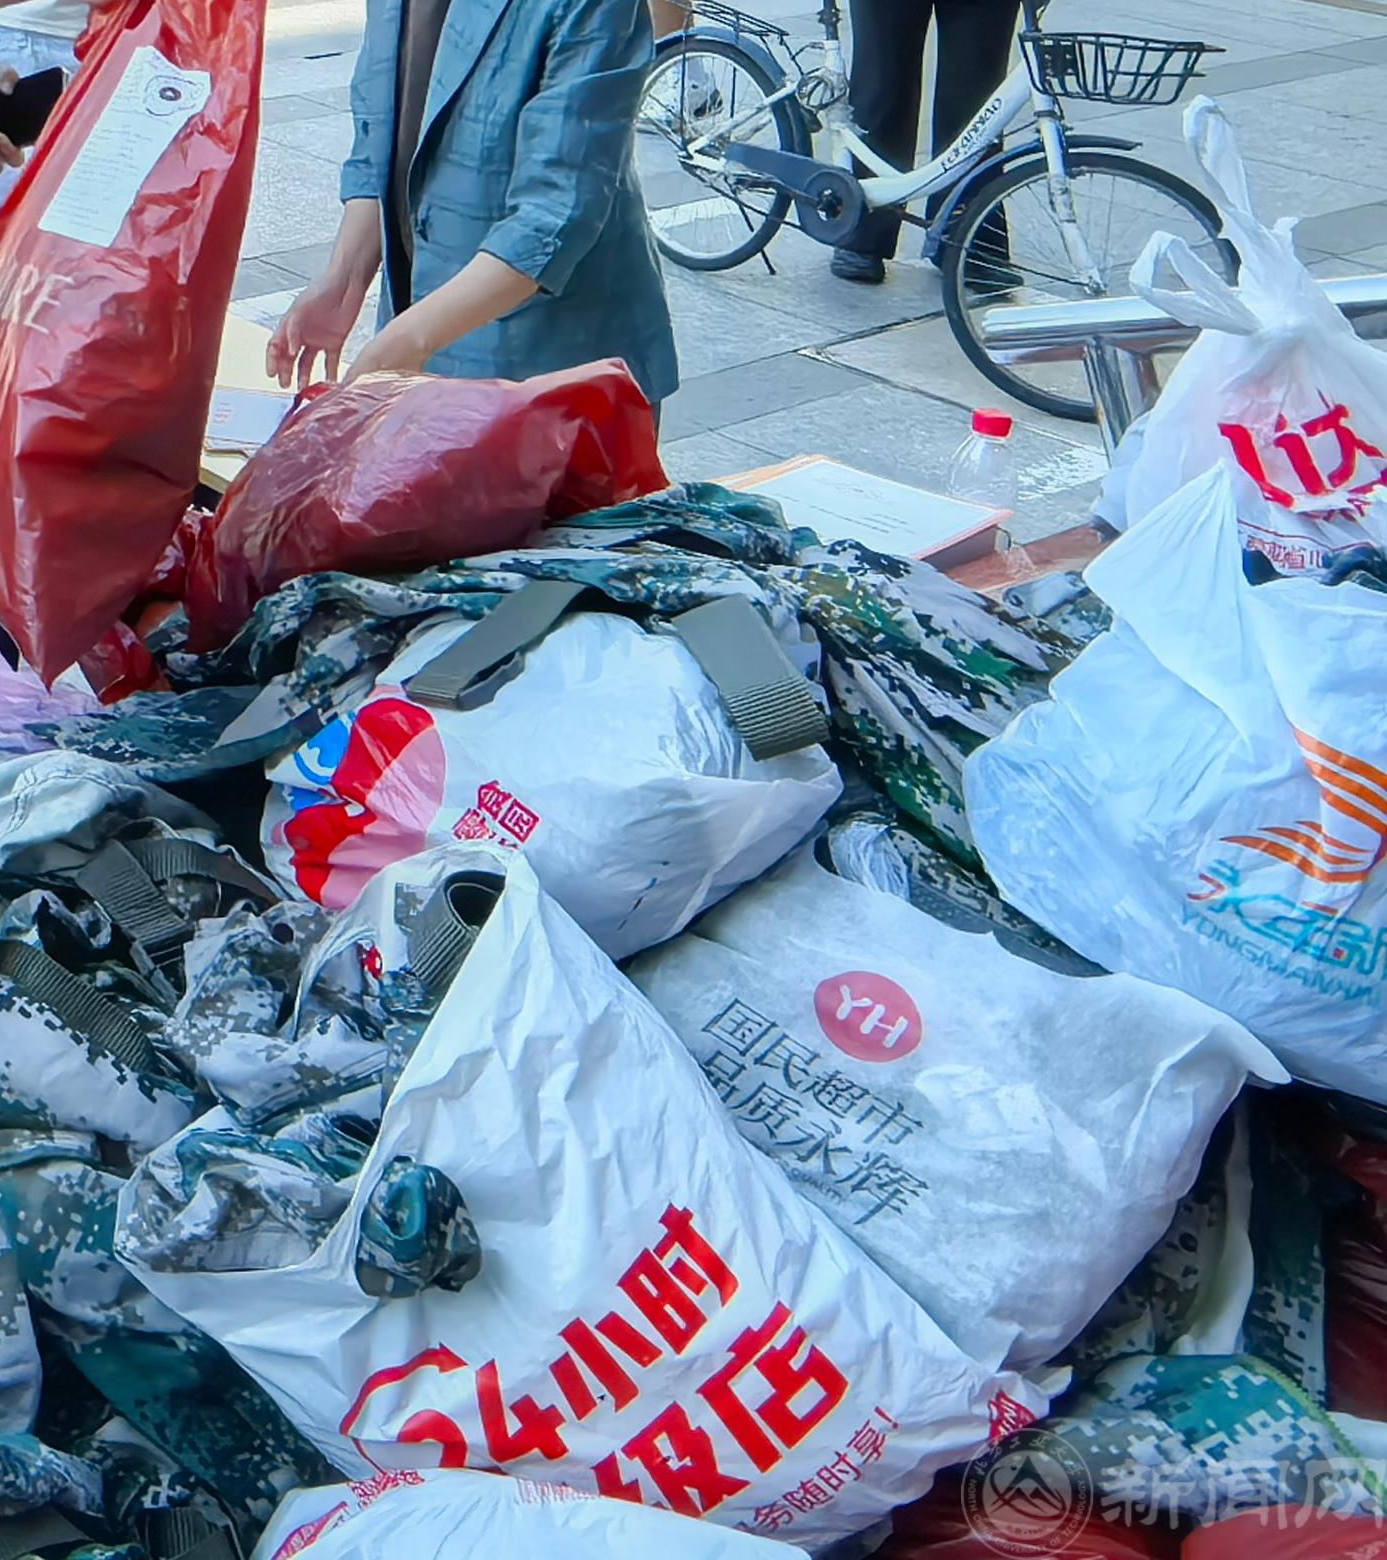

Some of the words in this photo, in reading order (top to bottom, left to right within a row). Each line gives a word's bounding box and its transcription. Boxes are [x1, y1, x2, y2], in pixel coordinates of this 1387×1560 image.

[701, 997, 925, 1144] 国民超市
[835, 984, 909, 1049] YH
[702, 1049, 929, 1226] 品质永辉
